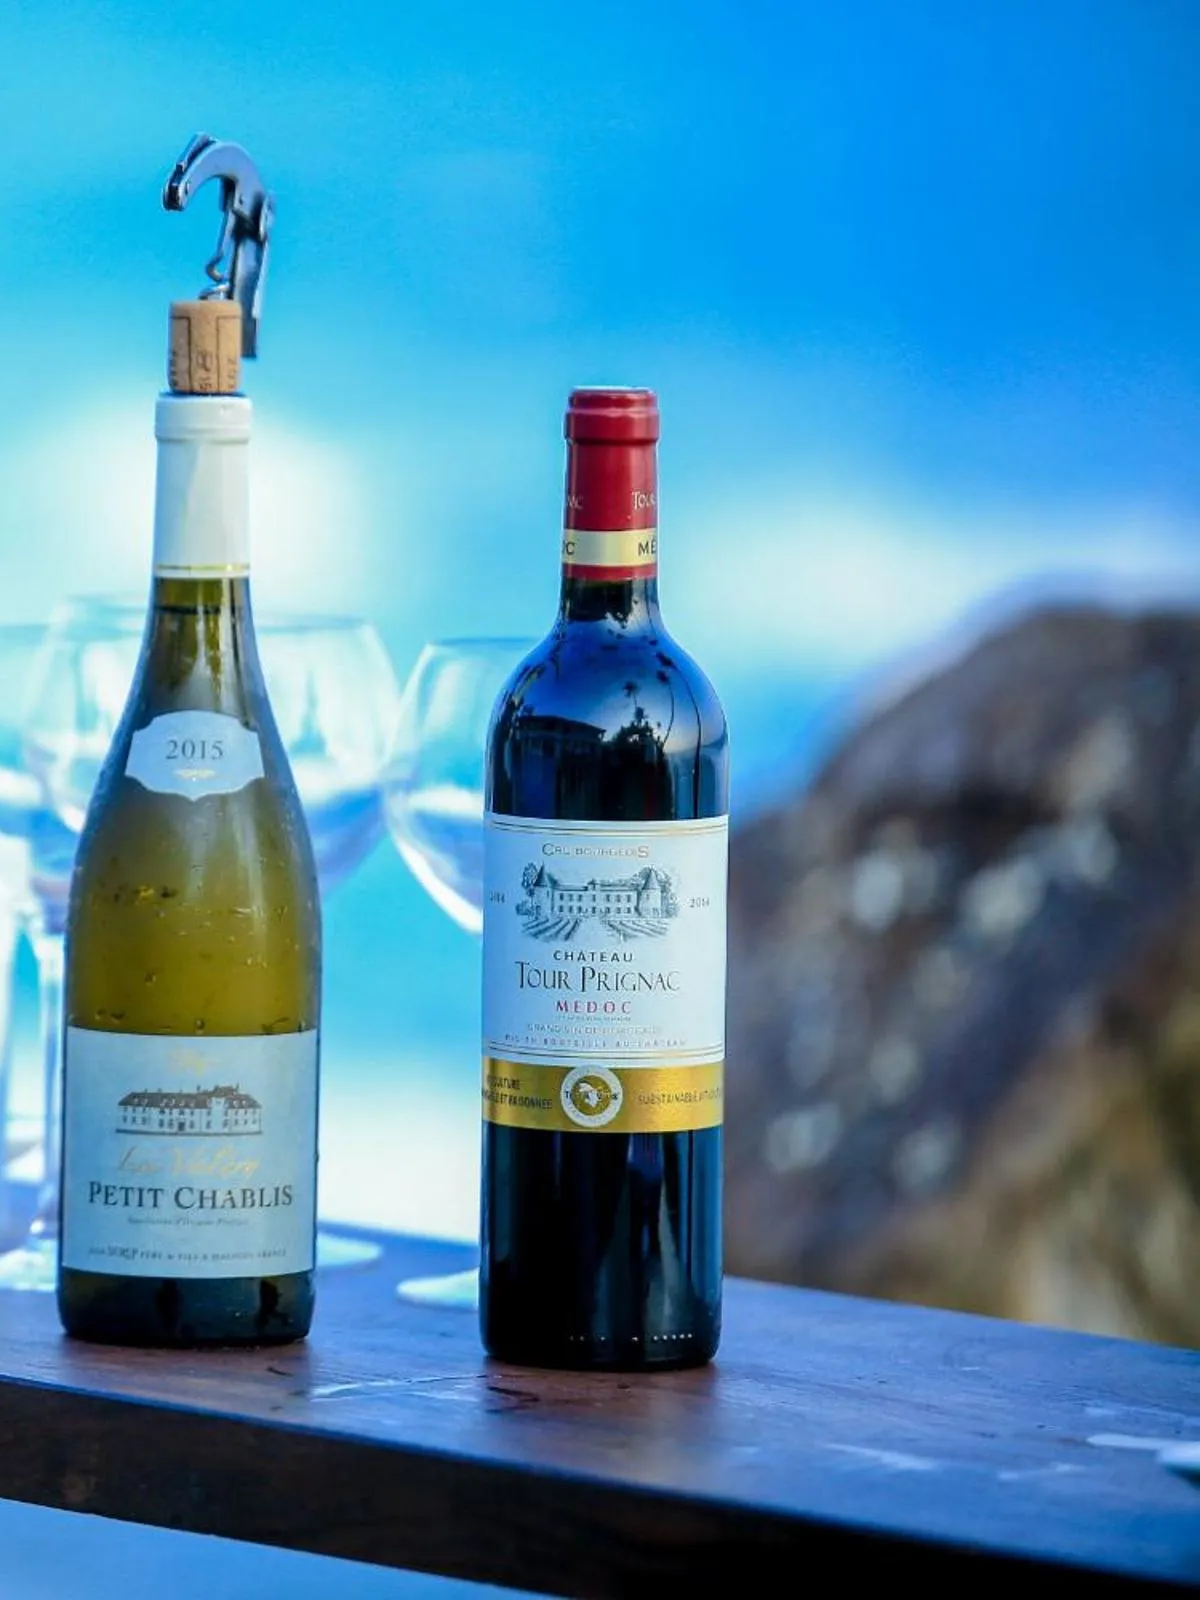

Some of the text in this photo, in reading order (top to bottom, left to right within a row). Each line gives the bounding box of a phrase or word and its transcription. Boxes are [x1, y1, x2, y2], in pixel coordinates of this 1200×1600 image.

[165, 739, 224, 760] 2015
[515, 960, 681, 993] TOUR PRIGNAC
[89, 1180, 293, 1210] PETIT CHABLIS
